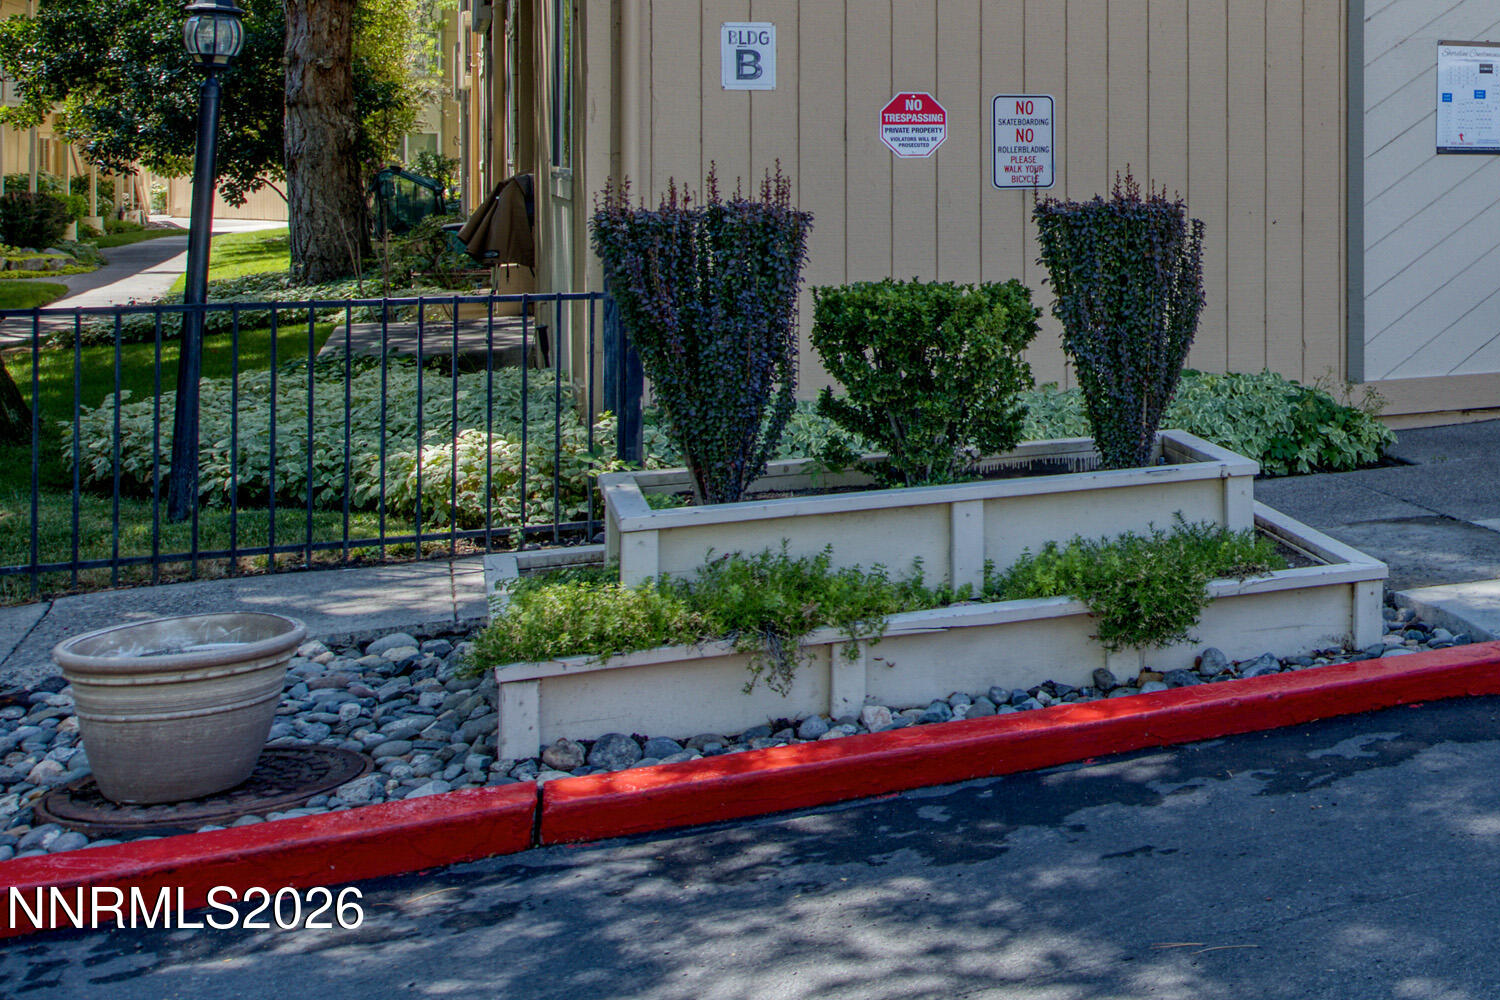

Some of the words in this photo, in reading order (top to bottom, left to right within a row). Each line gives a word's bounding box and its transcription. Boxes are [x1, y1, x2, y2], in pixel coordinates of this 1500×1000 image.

[728, 31, 770, 45] BLDG
[736, 49, 763, 80] B
[905, 99, 923, 111] NO
[1015, 100, 1034, 115] NO
[883, 113, 944, 123] TRESPASSING
[998, 118, 1049, 126] SKATEBOARDING
[1015, 128, 1034, 143] NO
[998, 145, 1050, 154] ROLLERBLADING
[1010, 155, 1038, 164] PLEASE
[1004, 165, 1023, 174] WALK
[1025, 165, 1044, 174] YOUR
[1011, 175, 1040, 184] BICYCLE
